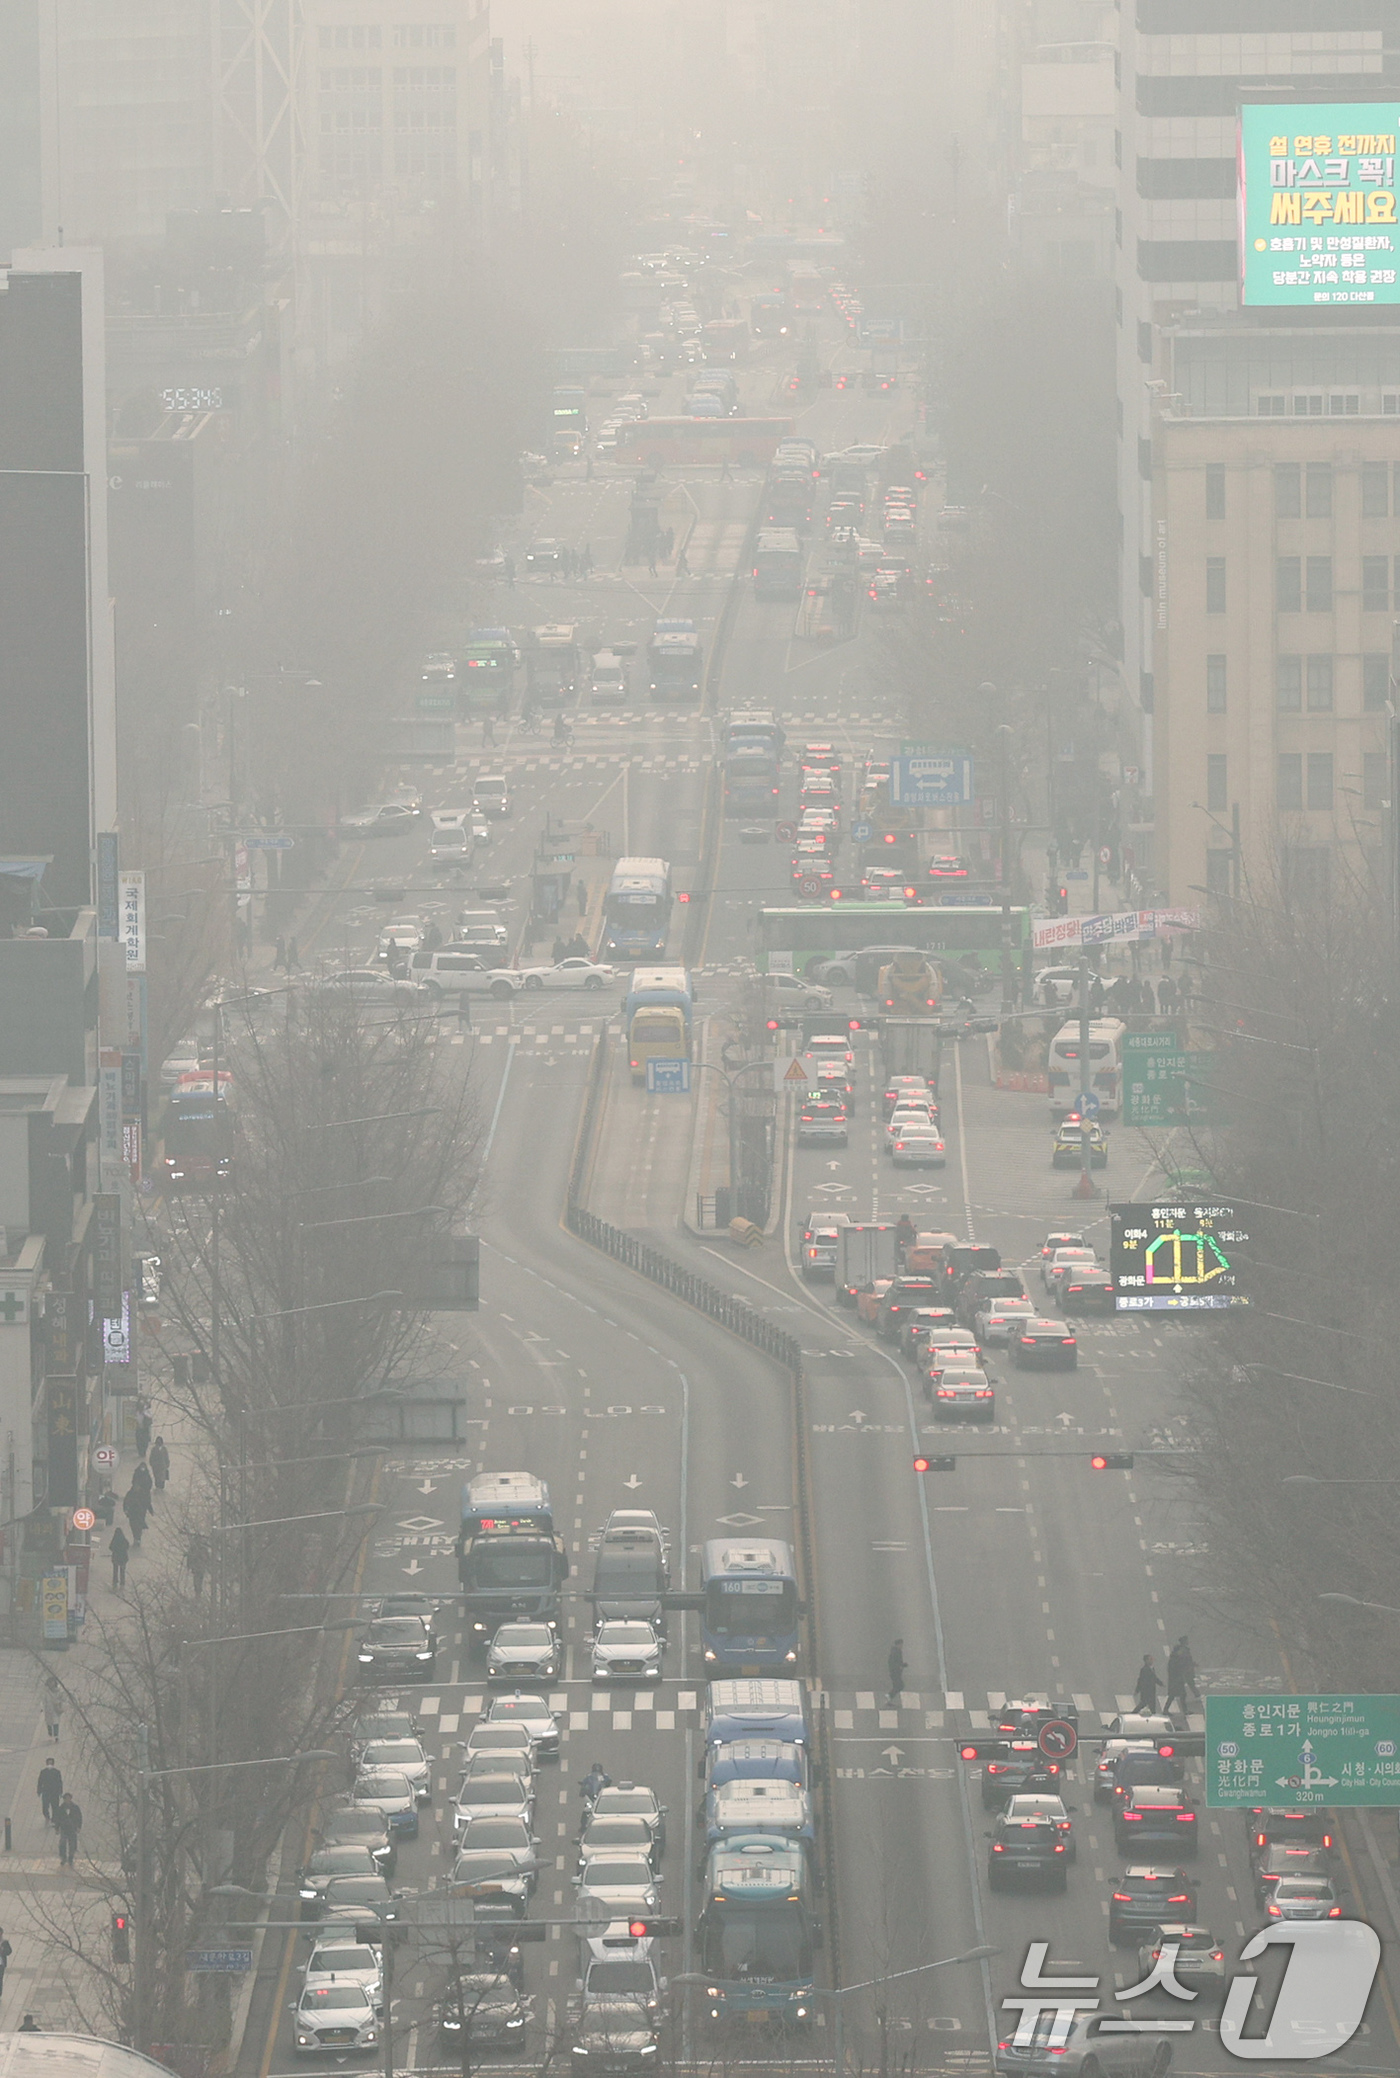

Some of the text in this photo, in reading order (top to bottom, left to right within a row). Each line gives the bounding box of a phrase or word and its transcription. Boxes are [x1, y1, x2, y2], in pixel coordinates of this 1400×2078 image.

[1269, 134, 1396, 157] 설 연휴 전까지
[1270, 157, 1394, 188] 마스크 꼭!
[1270, 190, 1398, 226] 써주세요
[1270, 237, 1306, 251] 호흡기
[1310, 236, 1323, 250] 및
[1299, 253, 1338, 268] 노약자
[1272, 269, 1396, 285] 당분간 지속 착용 권장
[1332, 291, 1348, 301] 120
[125, 887, 140, 961] 국제회계학원
[1151, 1207, 1186, 1219] 흥인지문
[1118, 1275, 1145, 1288] 광화문
[96, 1450, 115, 1468] 약
[723, 1582, 741, 1593] 160
[1242, 1703, 1301, 1720] 흥인지문
[1306, 1714, 1365, 1724] Heunginjimun
[1307, 1727, 1339, 1738] Jongno
[1217, 1759, 1265, 1774] 광화문
[1217, 1775, 1260, 1788] 光化門
